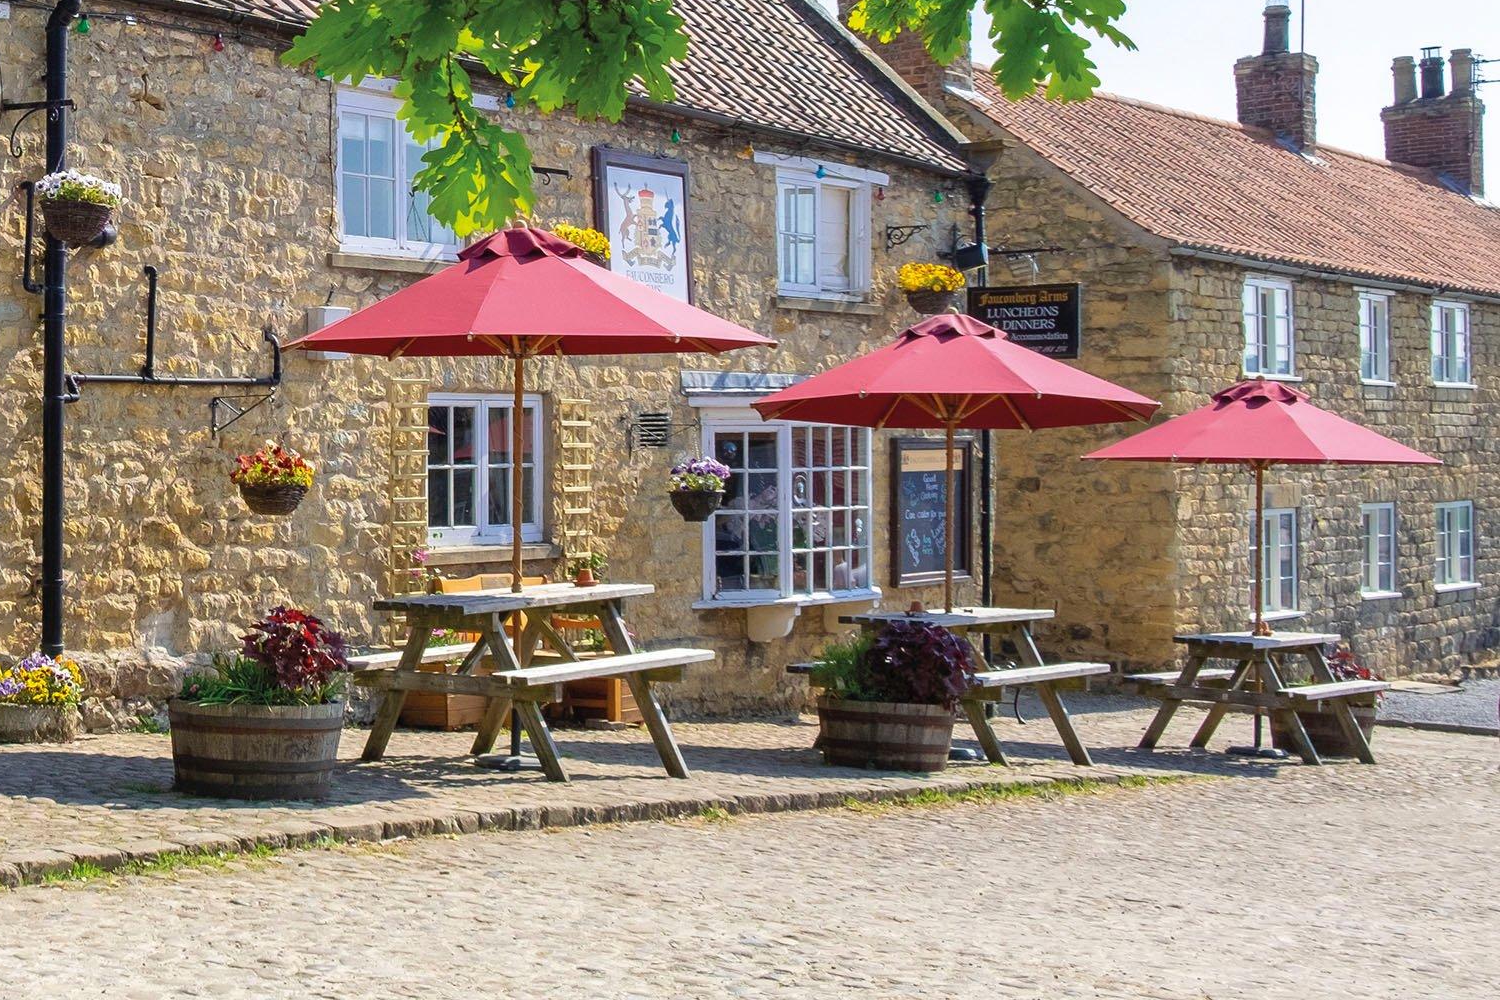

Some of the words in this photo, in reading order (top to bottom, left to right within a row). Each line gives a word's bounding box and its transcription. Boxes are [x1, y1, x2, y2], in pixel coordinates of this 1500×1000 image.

[979, 292, 1036, 306] Fauconberg
[1039, 290, 1068, 302] Arms
[987, 306, 1059, 318] LUNCHEONS
[1003, 319, 1056, 330] DINNERS
[1010, 332, 1068, 340] Accommodation
